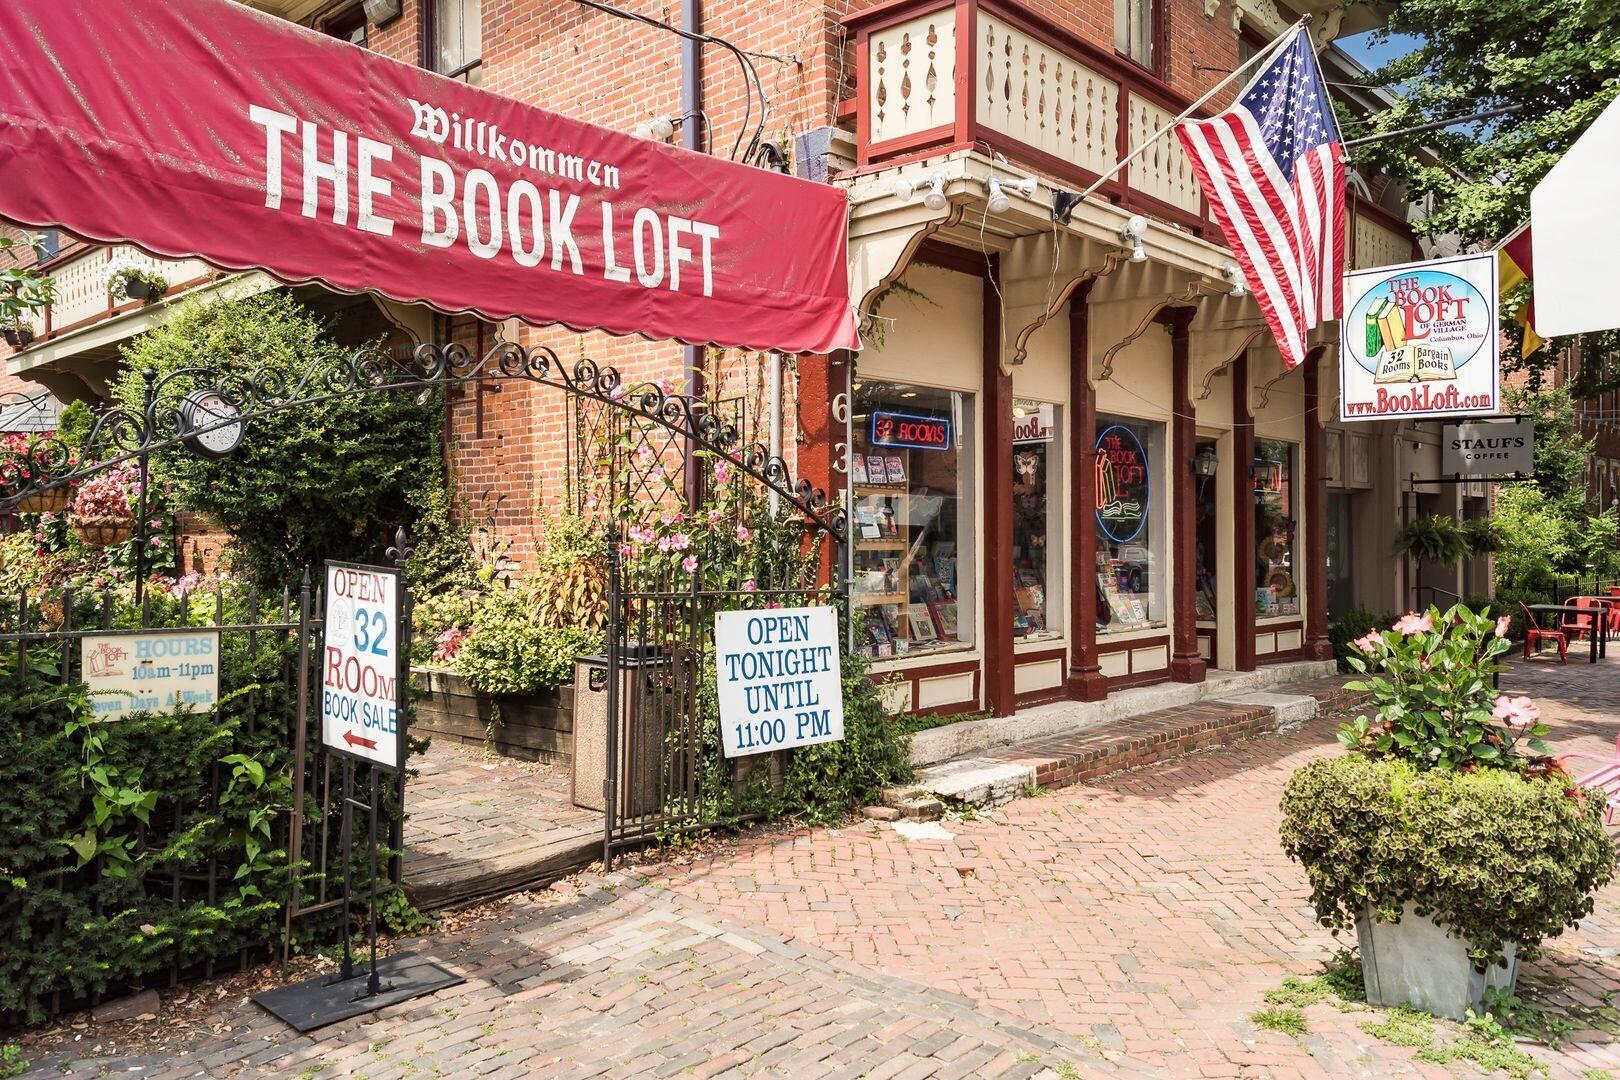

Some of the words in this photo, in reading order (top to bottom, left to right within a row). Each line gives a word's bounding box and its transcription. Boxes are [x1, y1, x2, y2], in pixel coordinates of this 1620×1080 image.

[407, 98, 620, 190] Willkommen
[249, 104, 395, 237] THE
[419, 156, 584, 276] BOOK
[601, 200, 720, 298] LOFT
[1387, 277, 1419, 293] THE
[1389, 285, 1453, 307] BOOK
[1400, 298, 1469, 341] LOFT
[1433, 319, 1467, 328] GERMAN
[1433, 325, 1467, 334] VILLAGE
[1466, 332, 1484, 340] Ohio
[1388, 350, 1404, 364] 32
[1417, 347, 1449, 361] Bargain
[1418, 359, 1449, 371] Books
[1382, 361, 1411, 375] Rooms
[1347, 384, 1491, 414] www.BookLoft.com
[876, 418, 894, 438] 32
[897, 422, 945, 443] ROOMS
[1451, 436, 1525, 450] STAUF'S
[1110, 450, 1136, 464] BOOK
[1466, 452, 1510, 460] COFFEE
[1113, 465, 1144, 497] LOFT
[334, 568, 388, 604] OPEN
[354, 608, 388, 656] 32
[747, 615, 810, 645] OPEN
[105, 652, 128, 667] LOFT
[135, 637, 212, 659] HOURS
[132, 663, 214, 680] 10am-11pm
[325, 646, 396, 702] ROOM
[725, 646, 832, 681] TONIGHT
[92, 699, 123, 712] even
[130, 694, 159, 712] Days
[182, 688, 213, 705] Week
[744, 679, 819, 714] UNTIL
[325, 690, 359, 724] BOOK
[363, 701, 397, 734] SALE
[735, 718, 786, 749] 11:00
[795, 709, 832, 740] PM
